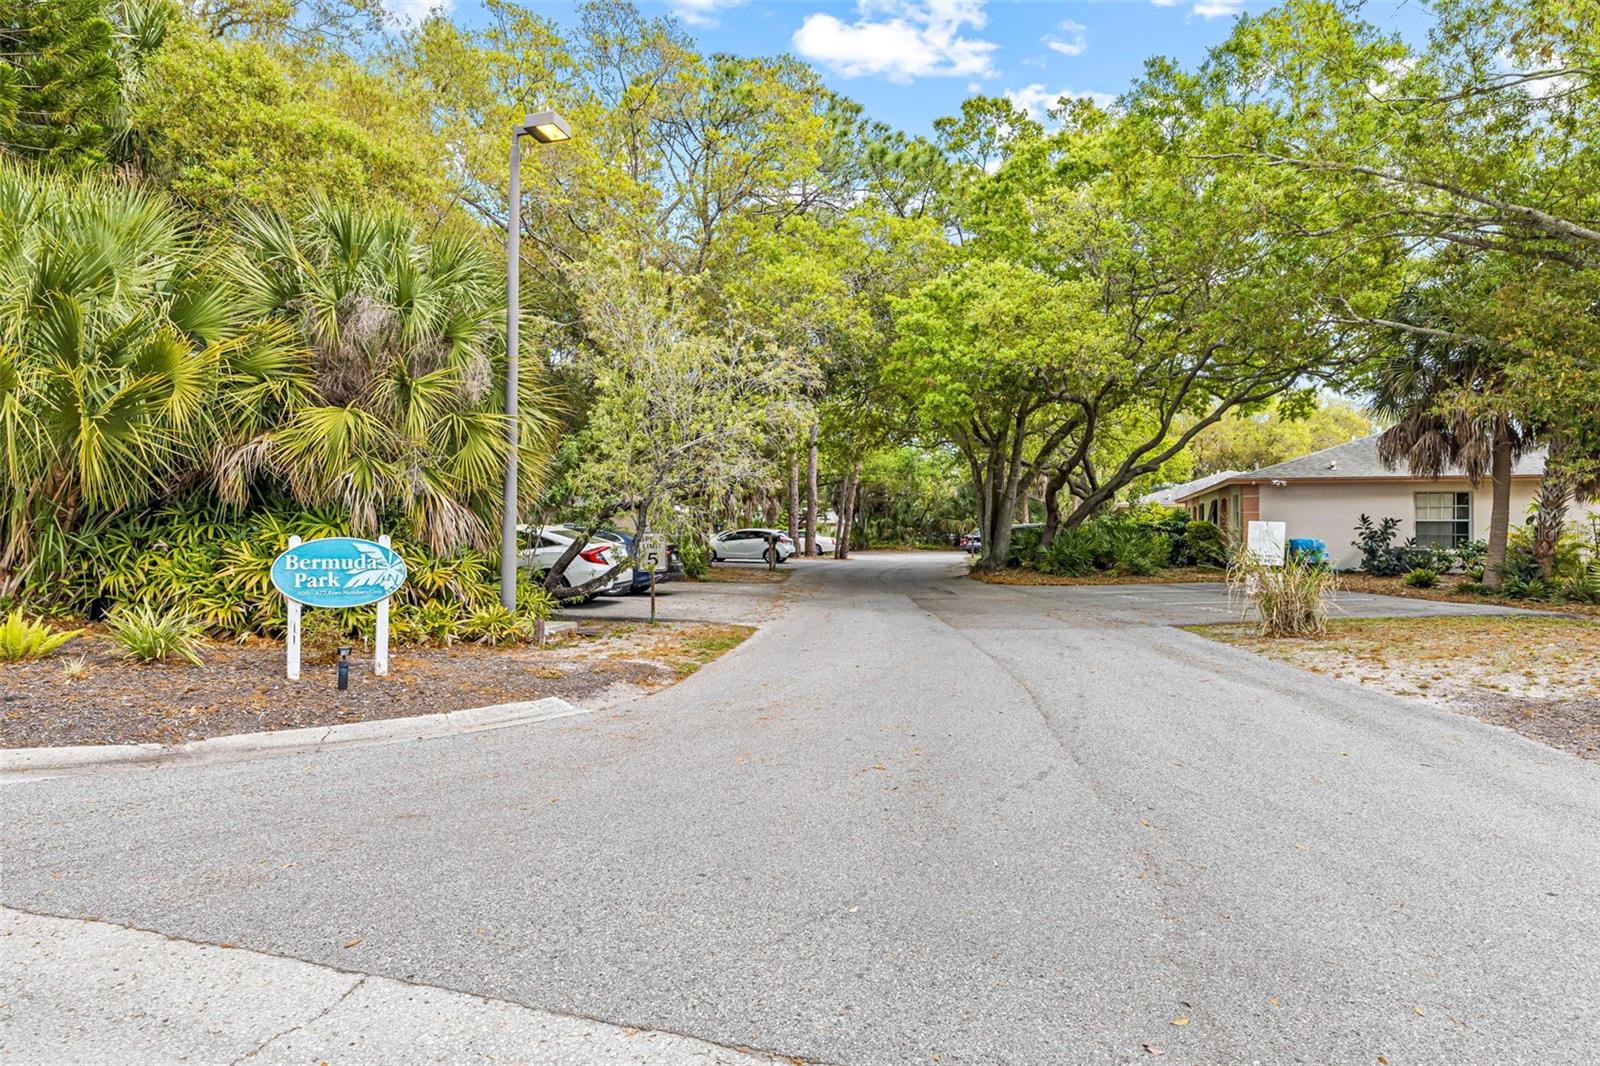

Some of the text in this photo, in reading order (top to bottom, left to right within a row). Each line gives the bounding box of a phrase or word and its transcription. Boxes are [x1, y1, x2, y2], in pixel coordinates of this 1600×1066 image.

[285, 554, 377, 570] Bermuda
[647, 552, 658, 567] 5
[294, 572, 341, 588] Park
